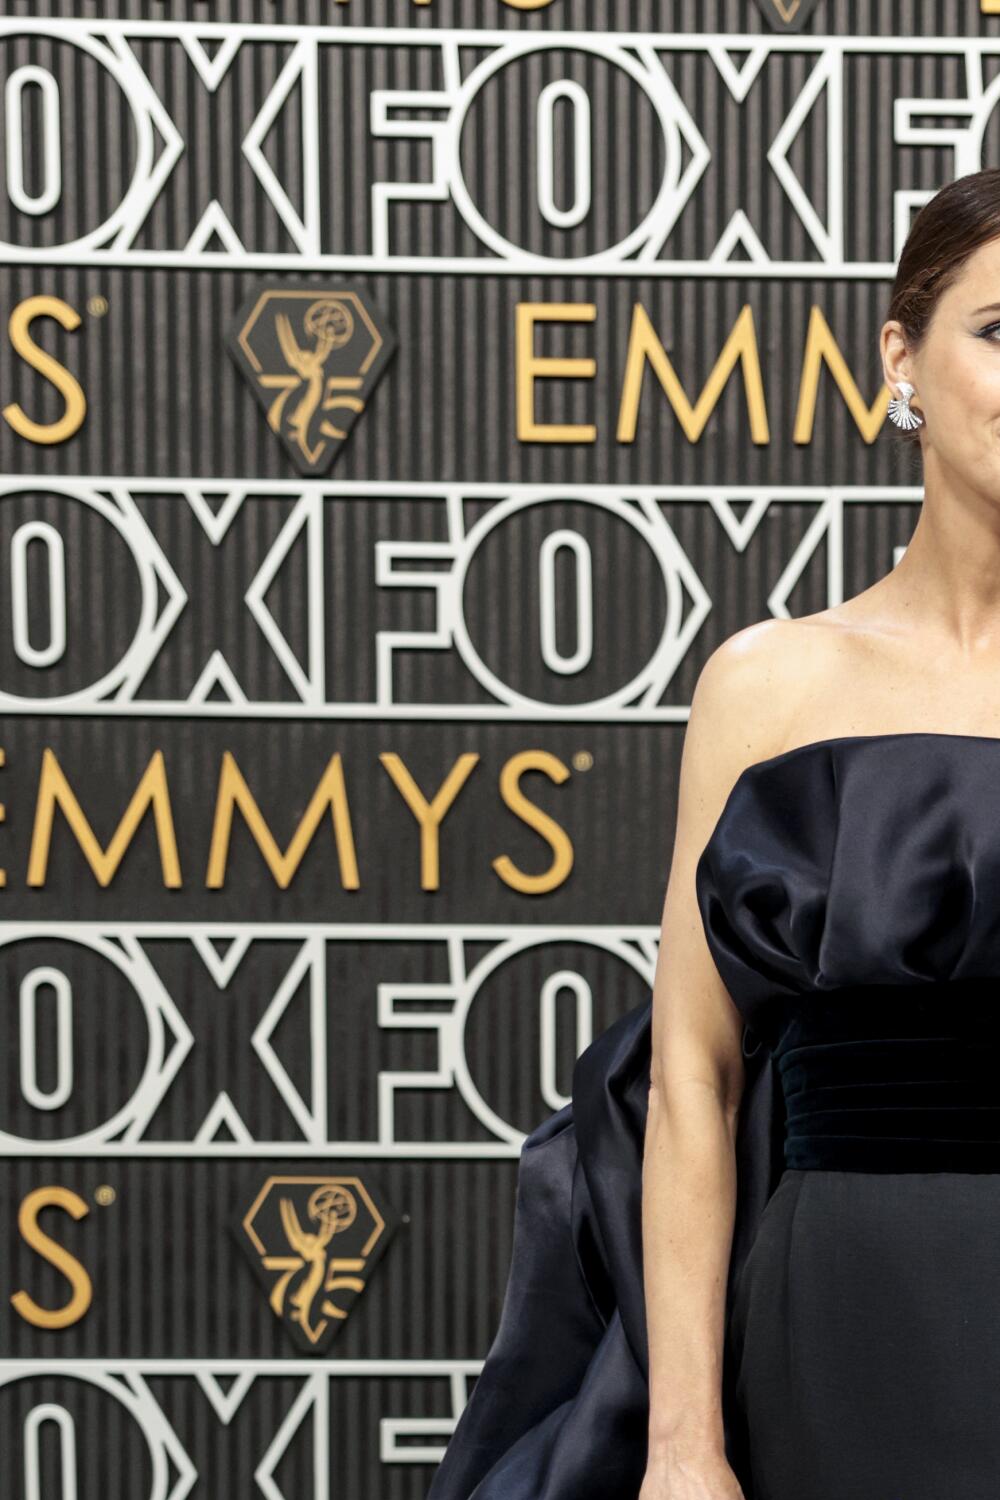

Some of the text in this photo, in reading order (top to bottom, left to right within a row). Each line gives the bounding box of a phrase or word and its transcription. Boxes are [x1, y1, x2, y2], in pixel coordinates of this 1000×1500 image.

[303, 24, 843, 277] FOX
[308, 479, 843, 721] FOX
[311, 924, 661, 1158] FO
